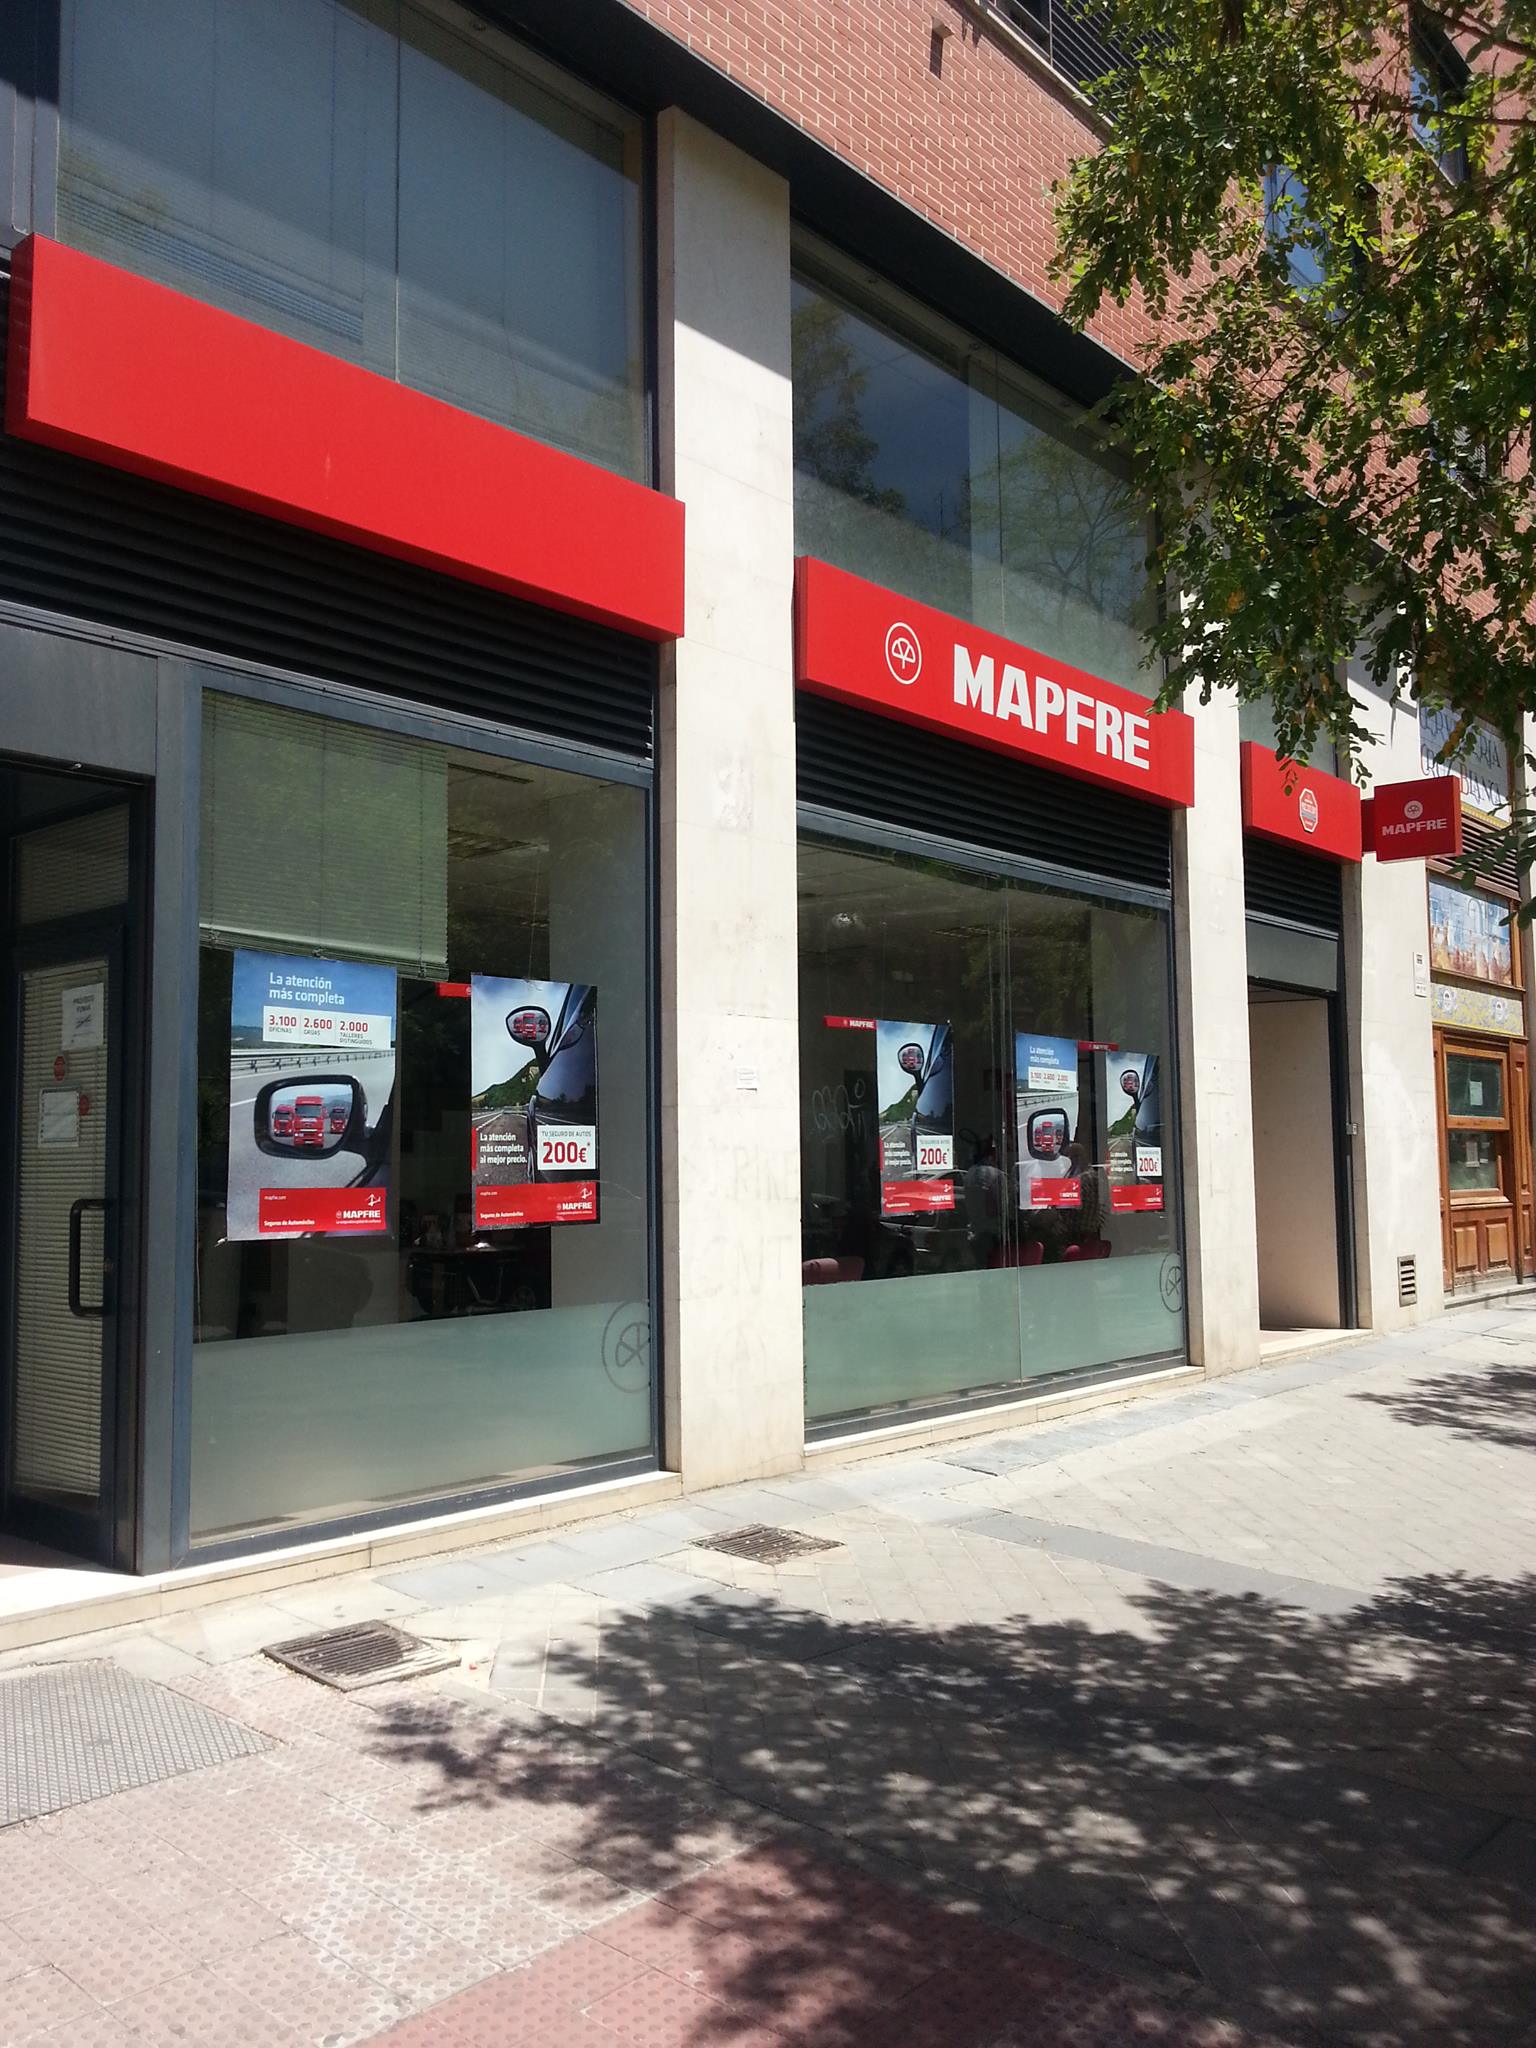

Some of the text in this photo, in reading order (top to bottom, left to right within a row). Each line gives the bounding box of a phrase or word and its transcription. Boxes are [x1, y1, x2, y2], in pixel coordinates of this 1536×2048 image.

[954, 643, 1150, 770] MAPFRE
[1382, 818, 1447, 836] MAPFRE
[270, 972, 332, 990] La atención
[269, 988, 345, 1006] más completa
[269, 1015, 297, 1027] 3.100
[304, 1018, 332, 1030] 2.600
[340, 1021, 368, 1032] 2.000
[849, 1020, 875, 1028] MAPFRE
[480, 1132, 516, 1142] La atención
[480, 1144, 524, 1154] más completa
[480, 1155, 527, 1165] al mejor precio.
[562, 1202, 592, 1210] MAPFRE
[343, 1210, 381, 1219] MAPFRE
